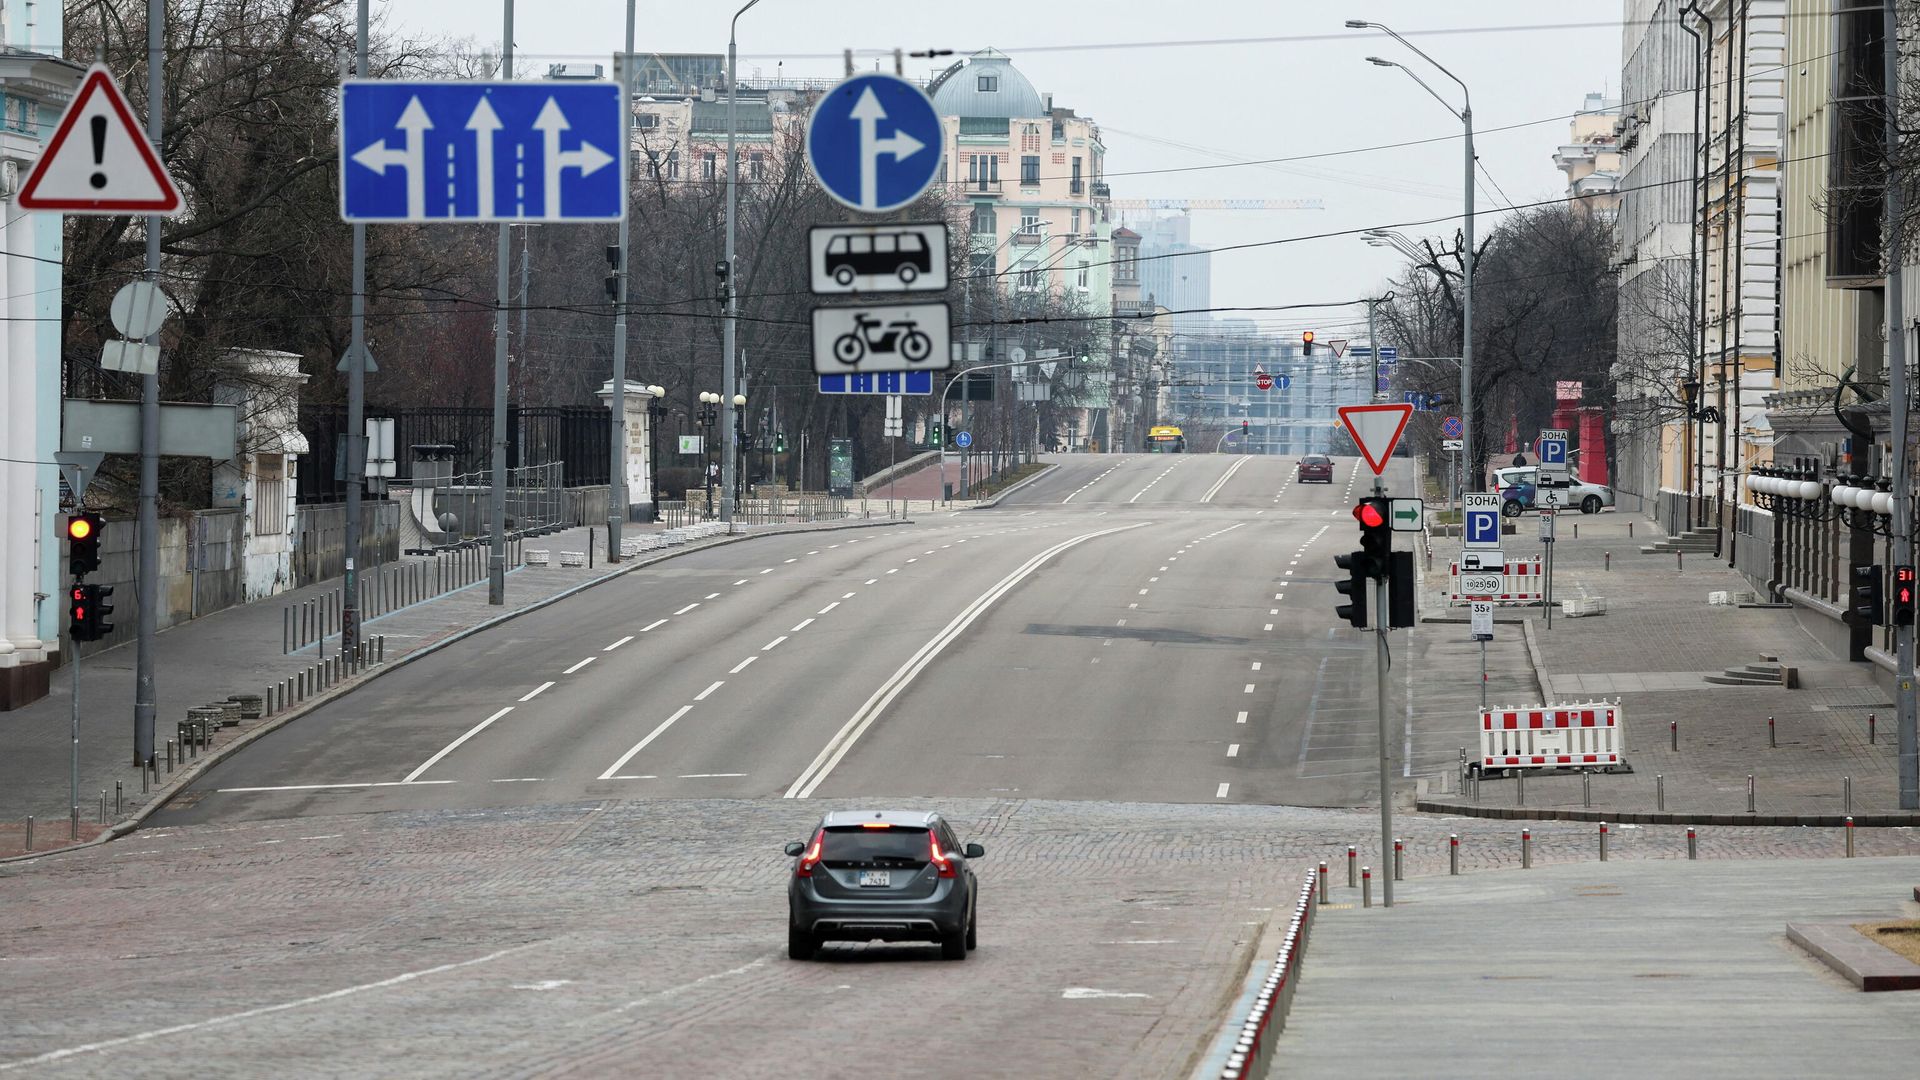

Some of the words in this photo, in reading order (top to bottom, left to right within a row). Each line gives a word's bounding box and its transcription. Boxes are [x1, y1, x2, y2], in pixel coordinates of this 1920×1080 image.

[1541, 431, 1567, 440] ЗОНА
[1547, 442, 1561, 462] P
[1466, 496, 1499, 506] ЗОНА
[1475, 514, 1493, 540] P
[1899, 570, 1912, 580] 31
[1486, 580, 1497, 589] 50
[74, 590, 81, 600] 6
